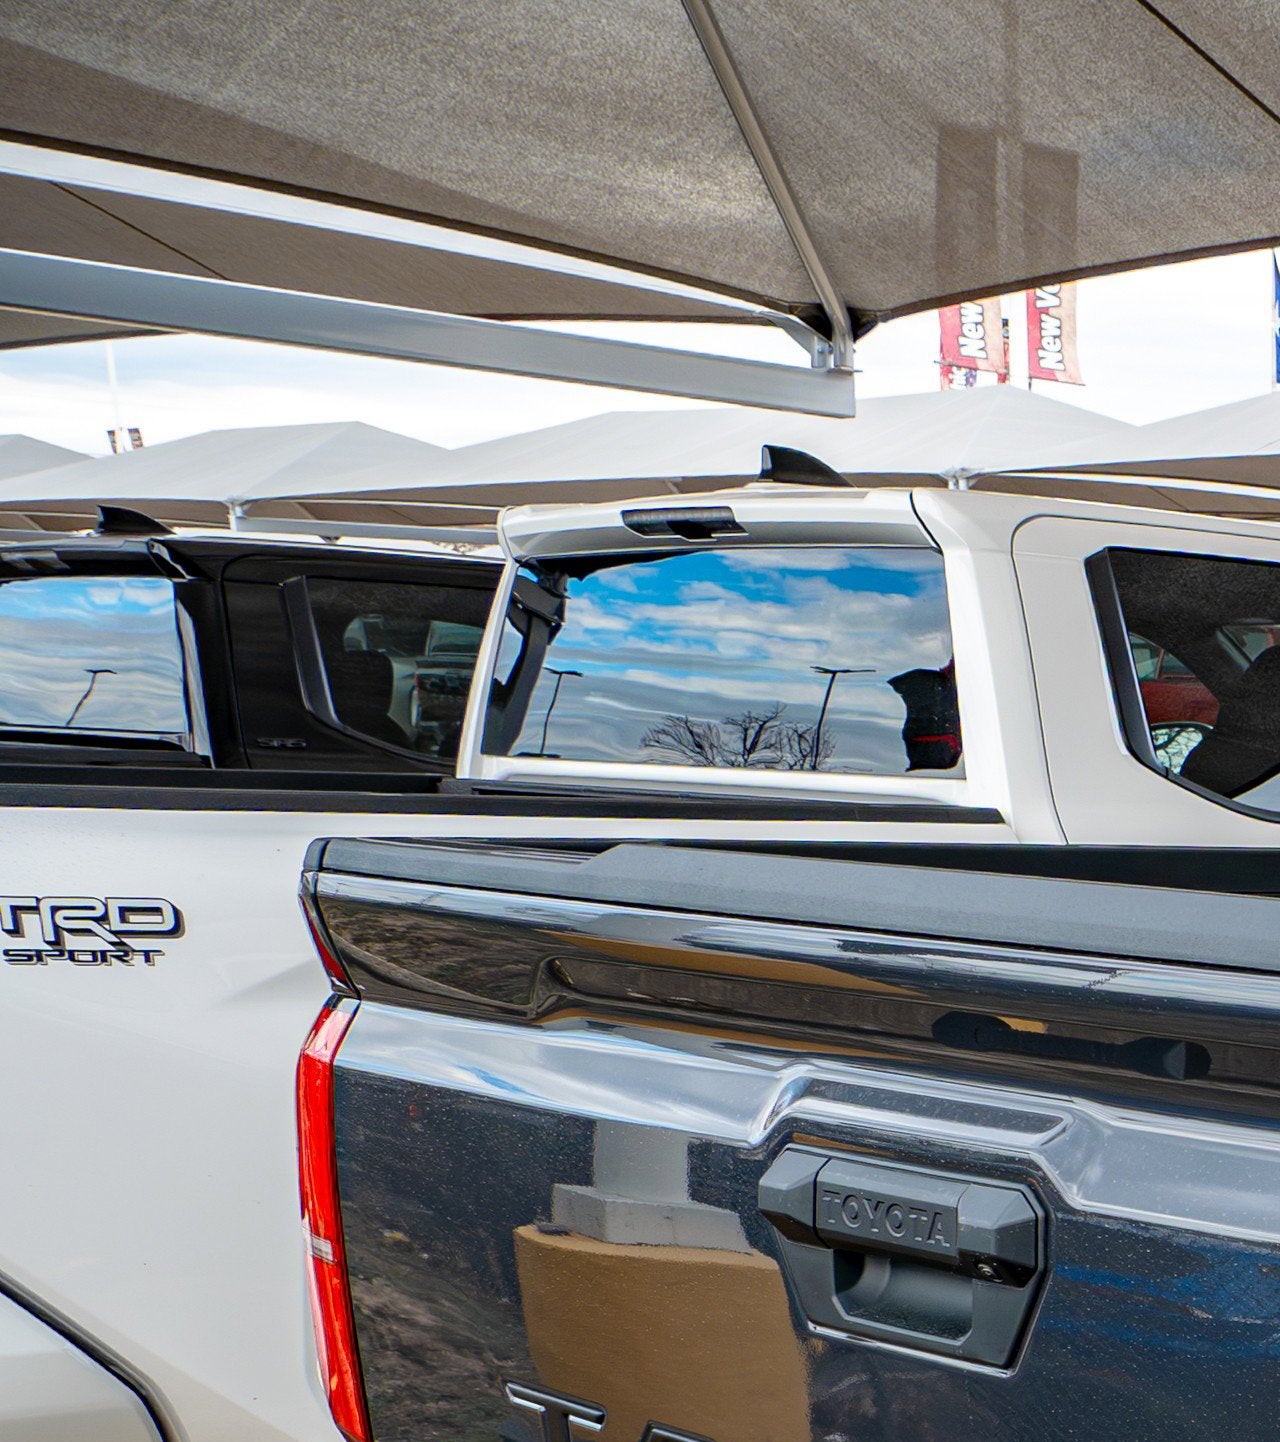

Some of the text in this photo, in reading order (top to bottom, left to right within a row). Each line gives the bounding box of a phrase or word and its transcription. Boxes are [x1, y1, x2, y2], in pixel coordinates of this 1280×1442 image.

[1038, 312, 1066, 371] New
[0, 896, 184, 949] TRD
[3, 949, 165, 966] SPORT
[822, 1188, 951, 1247] TOYOTA
